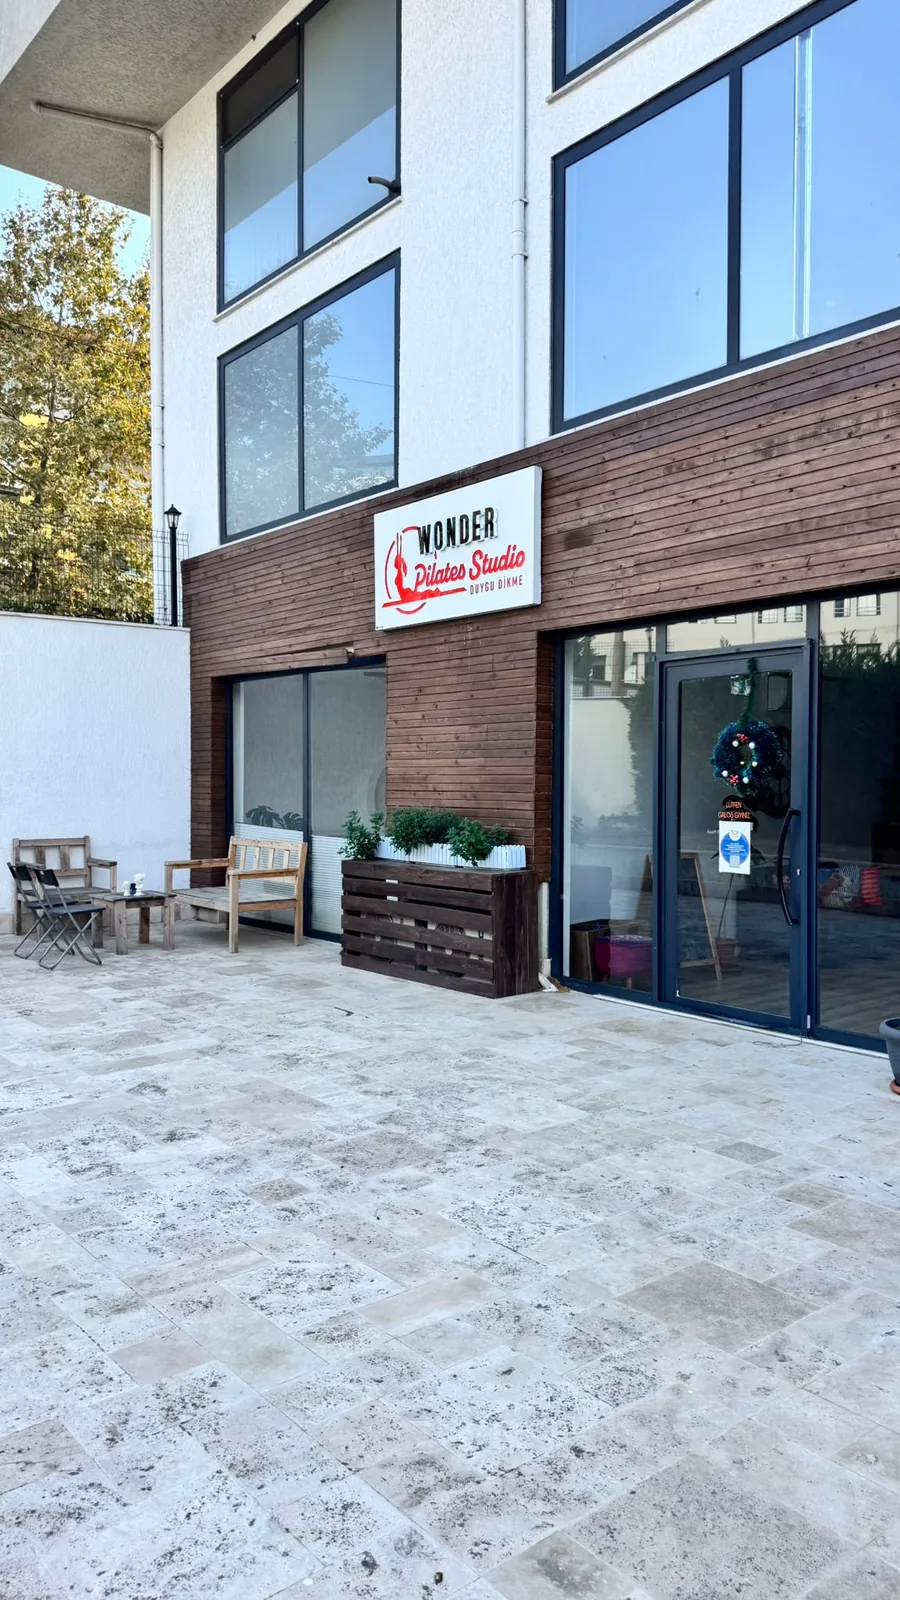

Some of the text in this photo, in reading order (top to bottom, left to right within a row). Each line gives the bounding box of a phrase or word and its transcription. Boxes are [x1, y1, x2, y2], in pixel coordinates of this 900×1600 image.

[418, 507, 495, 555] WONDER
[414, 545, 526, 592] Pilates Studio
[470, 575, 523, 595] DUYGU DİKME
